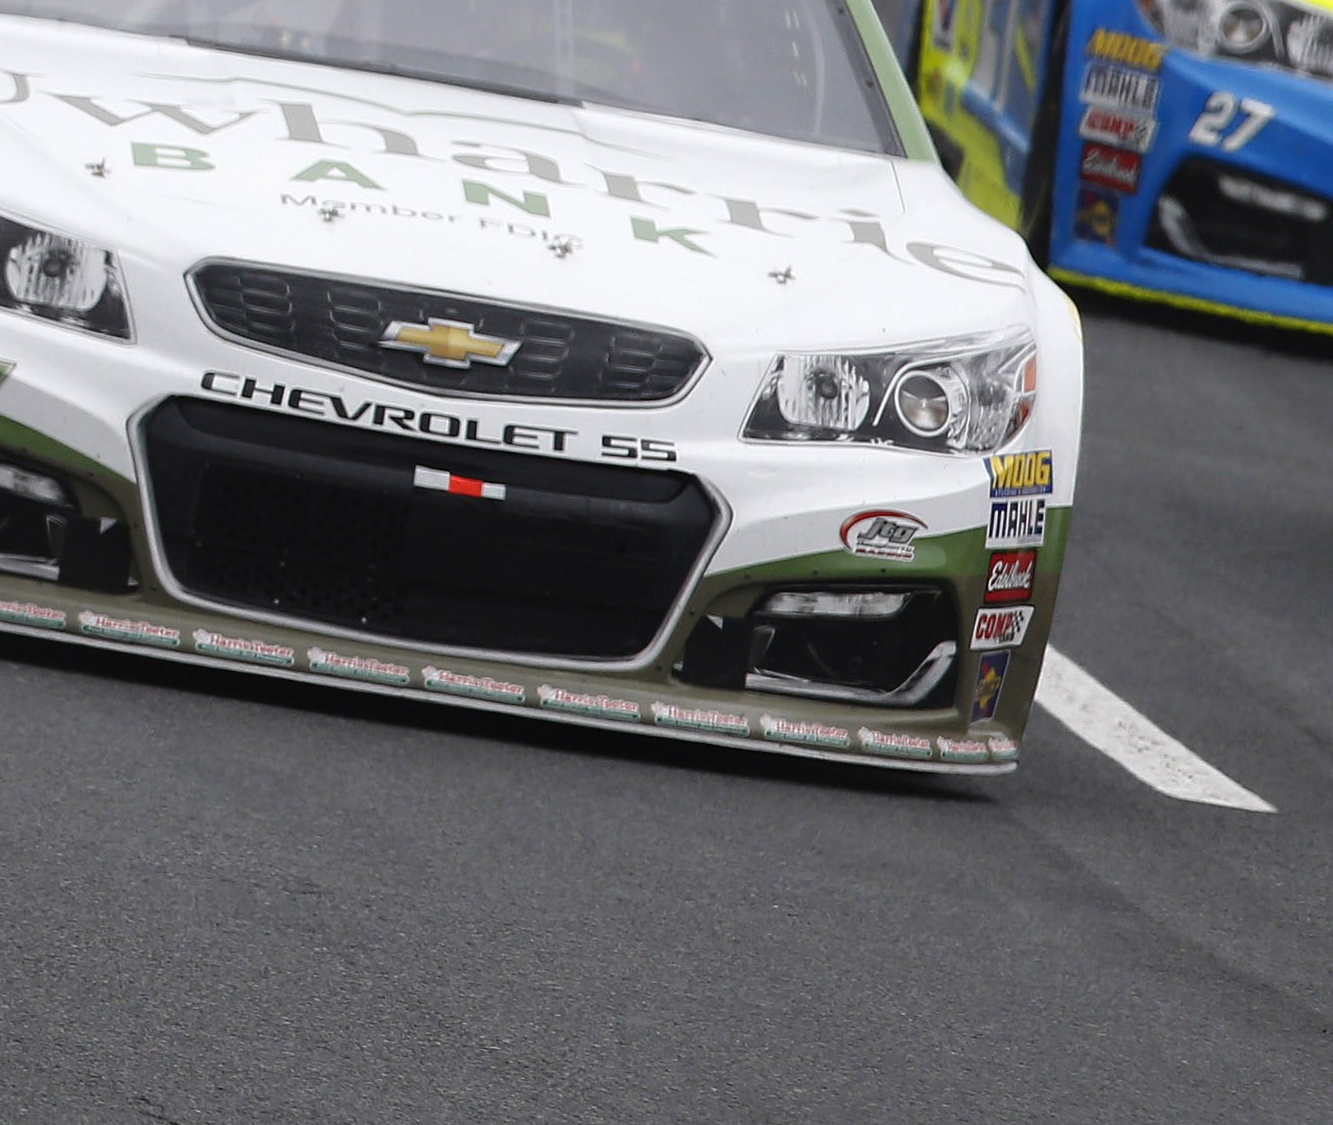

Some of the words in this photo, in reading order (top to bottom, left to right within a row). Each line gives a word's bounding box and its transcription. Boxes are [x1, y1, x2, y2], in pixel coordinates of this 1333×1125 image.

[1189, 91, 1276, 151] 27
[131, 142, 718, 258] BANK
[201, 372, 578, 452] CHEVROLET
[601, 434, 678, 463] SS
[991, 452, 1051, 489] MOOG
[989, 499, 1046, 539] MAHLE
[975, 613, 1014, 640] COMP
